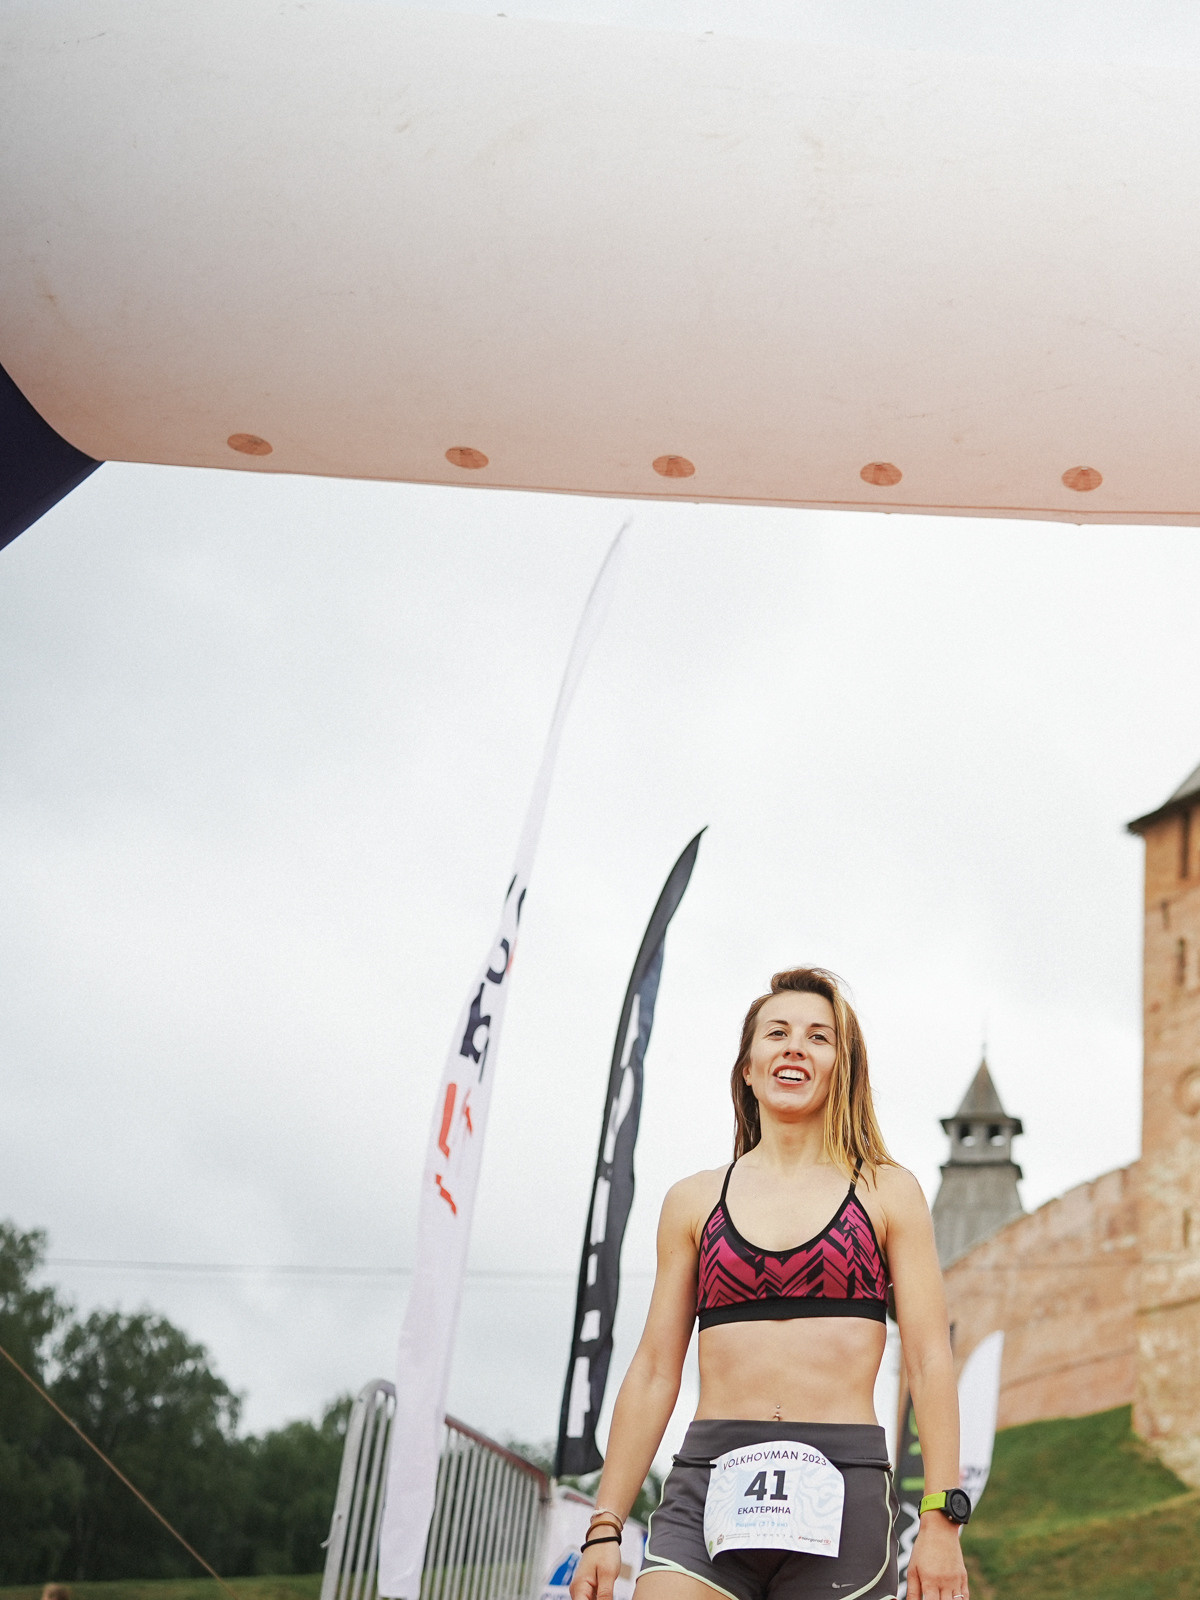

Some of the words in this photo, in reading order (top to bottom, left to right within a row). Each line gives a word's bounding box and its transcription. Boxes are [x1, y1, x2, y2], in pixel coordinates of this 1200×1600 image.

[723, 1451, 798, 1470] VOLKHOVMAN
[801, 1452, 827, 1466] 2023
[744, 1470, 789, 1501] 41
[737, 1506, 792, 1515] ЕКАТЕРИНА
